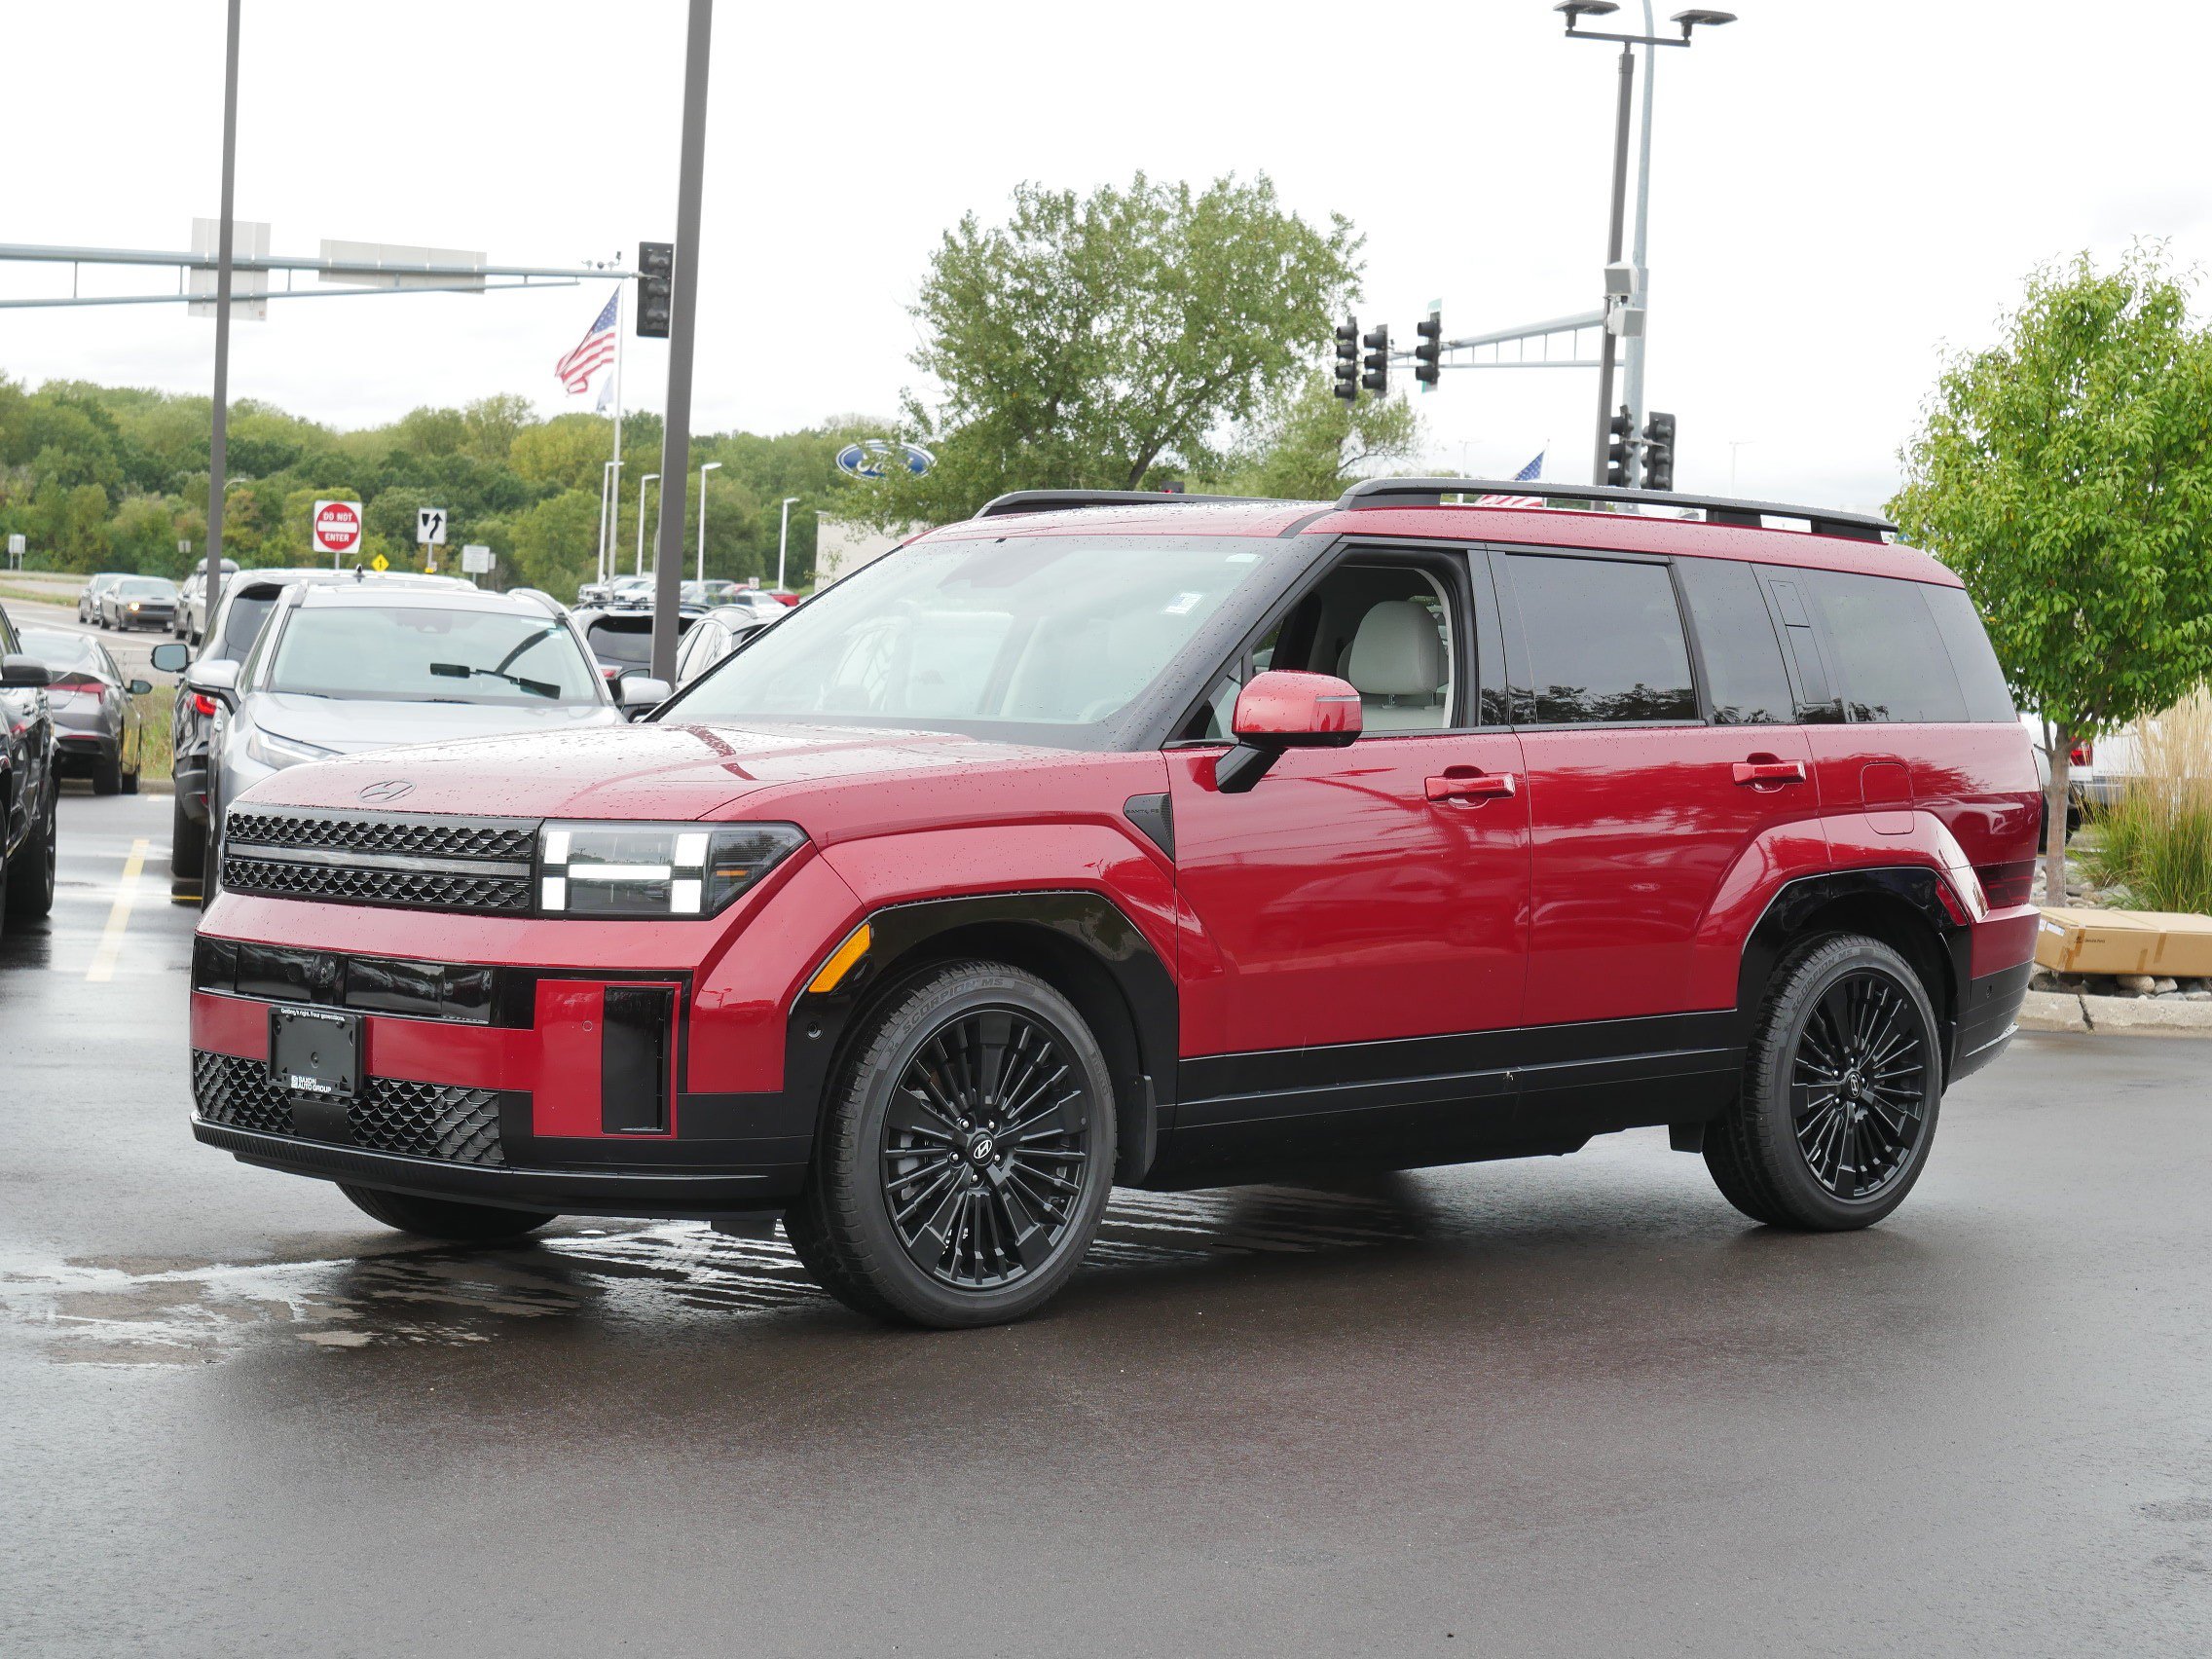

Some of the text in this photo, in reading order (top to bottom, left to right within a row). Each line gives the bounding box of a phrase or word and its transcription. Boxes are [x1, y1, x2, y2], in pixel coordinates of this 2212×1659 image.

[323, 512, 352, 521] DO NOT
[324, 534, 350, 542] ENTER
[903, 977, 1004, 1032] SCORPION MS
[281, 1008, 296, 1016] Getting
[298, 1076, 316, 1086] SAXON
[298, 1082, 312, 1090] AUTO
